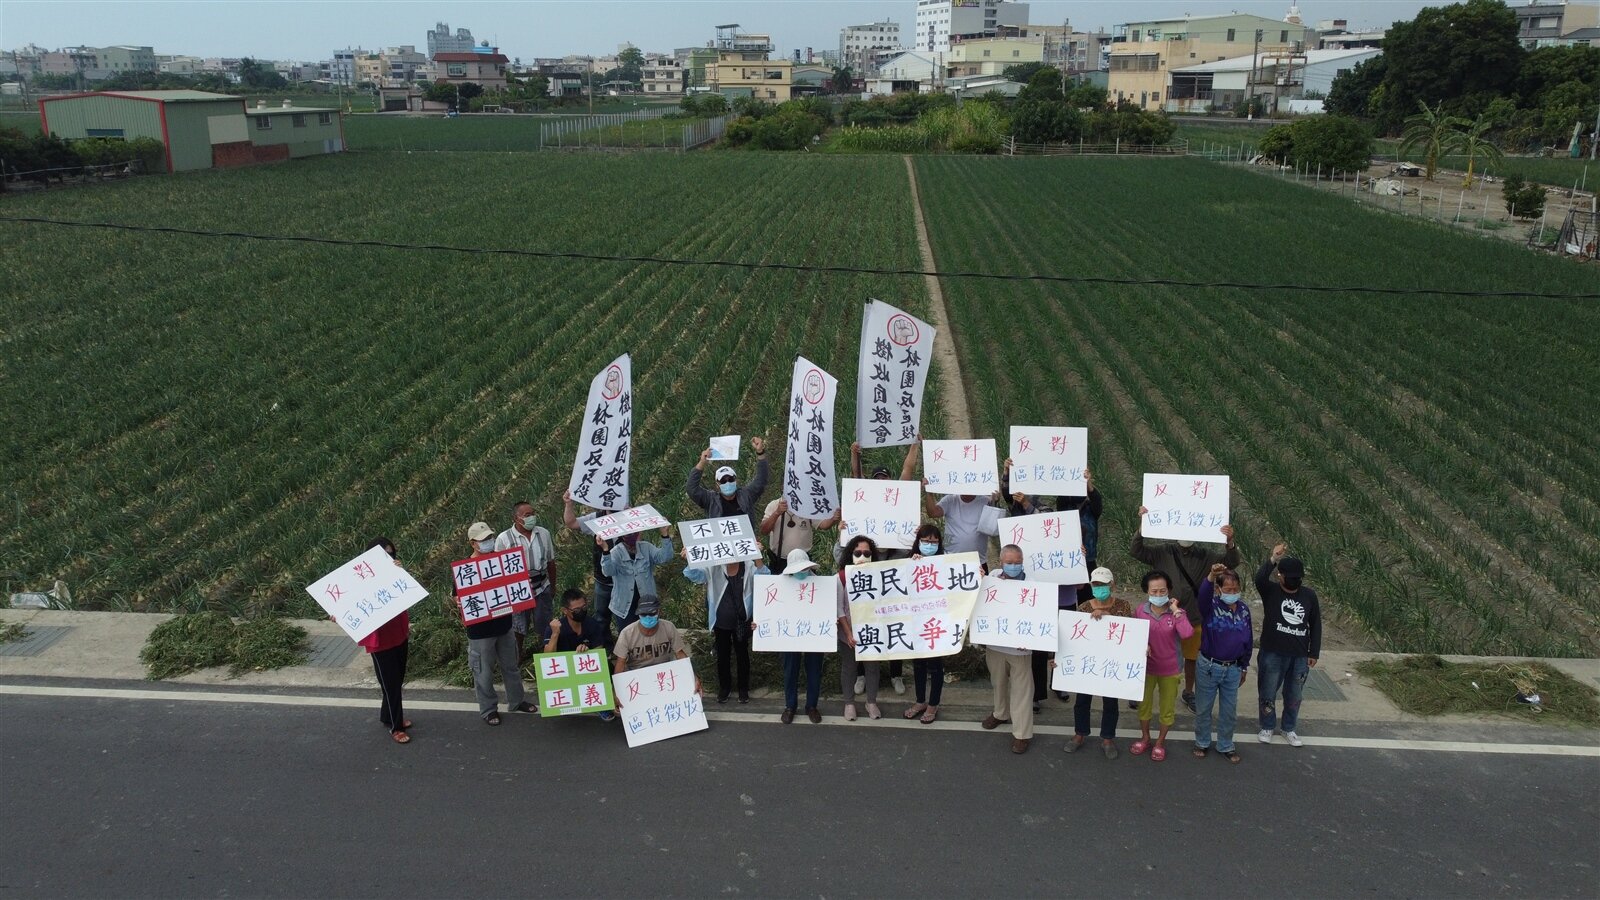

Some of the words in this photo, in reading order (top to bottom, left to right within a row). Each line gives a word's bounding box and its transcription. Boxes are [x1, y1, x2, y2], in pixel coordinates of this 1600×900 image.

[933, 445, 980, 462] 反對
[1019, 435, 1068, 455] 反對
[928, 471, 997, 486] 區段徵收
[1014, 465, 1085, 482] 區段徵收
[853, 488, 901, 505] 反對
[1154, 480, 1214, 499] 反對
[847, 519, 919, 536] 區段徵收
[1148, 509, 1225, 527] 區段徵收
[693, 521, 740, 537] 不准
[1012, 518, 1065, 545] 反對
[688, 540, 756, 561] 動我家
[1030, 551, 1086, 570] 段徵收
[455, 554, 525, 586] 停止掠
[324, 560, 375, 602] 反對
[849, 563, 979, 601] 與民徵地
[344, 577, 418, 631] 區段徵收
[462, 582, 531, 618] 奪土地
[765, 583, 818, 606] 反對
[985, 588, 1038, 607] 反對
[758, 619, 833, 638] 區段徵收
[977, 615, 1054, 635] 區段徵收
[1071, 620, 1130, 645] 反對
[1276, 623, 1307, 636] Timberland
[547, 655, 599, 676] 土地
[1062, 654, 1143, 681] 區段徵收
[550, 684, 602, 707] 正義
[627, 670, 678, 702] 反對
[629, 699, 702, 734] 區段徵收
